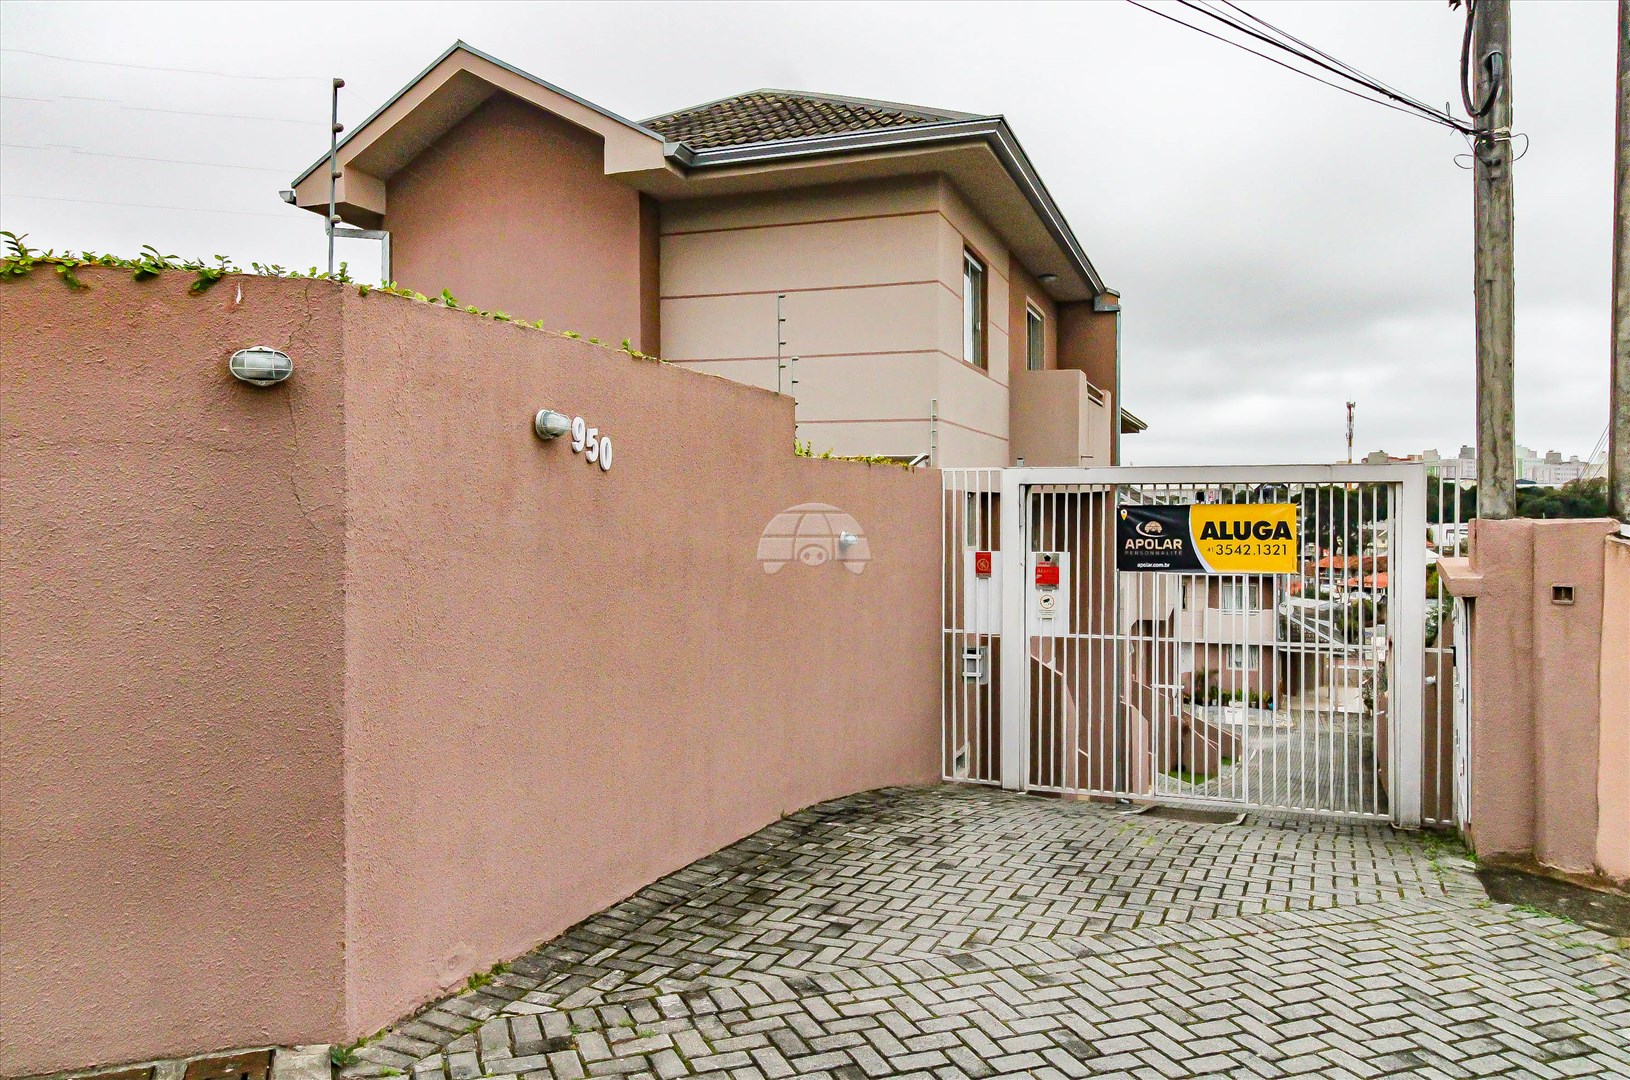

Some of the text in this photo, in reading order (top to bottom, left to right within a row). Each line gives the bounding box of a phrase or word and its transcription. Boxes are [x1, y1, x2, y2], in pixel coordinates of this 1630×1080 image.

[571, 416, 613, 471] 950
[1200, 520, 1293, 541] ALUGA
[1125, 538, 1183, 550] APOLAR
[1216, 544, 1287, 556] 3542.1321
